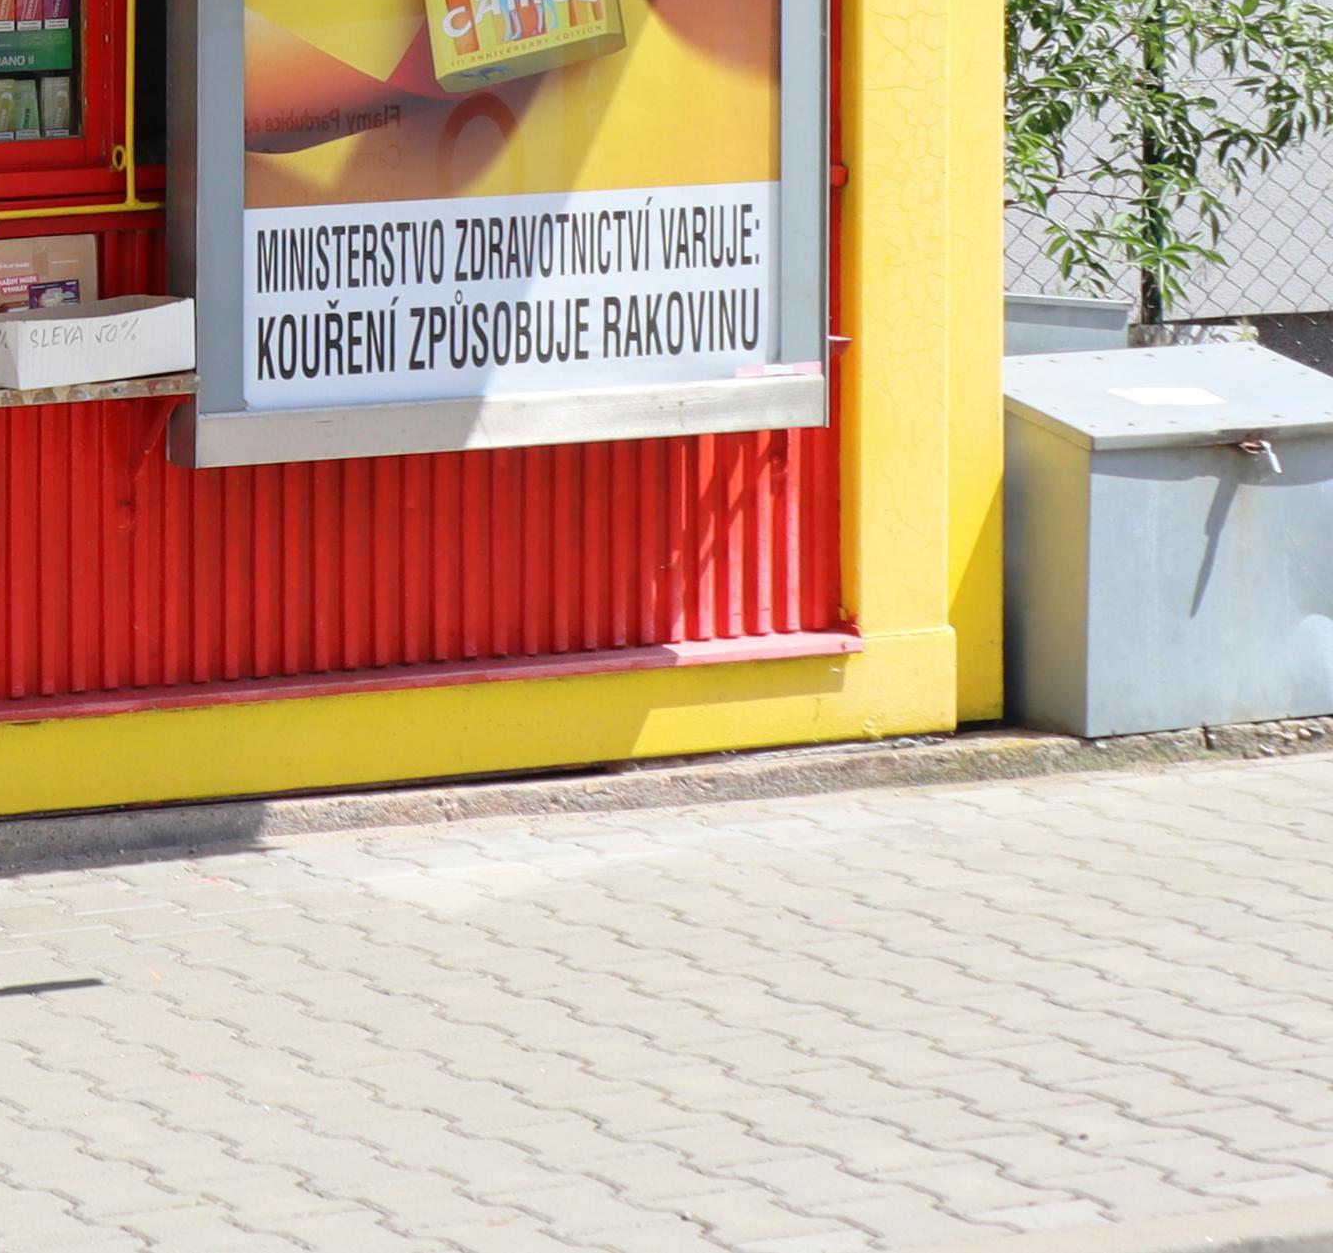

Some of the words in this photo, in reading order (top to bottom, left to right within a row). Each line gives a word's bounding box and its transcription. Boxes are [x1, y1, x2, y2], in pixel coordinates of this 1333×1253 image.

[470, 35, 551, 63] ANNIVERSARY
[554, 23, 604, 44] EDITION
[255, 218, 445, 295] MINISTERSTVO
[453, 196, 654, 284] ZDRAVOTNICTVÍ
[658, 203, 761, 270] VARUJE:
[29, 325, 85, 350] SLEVA
[94, 317, 139, 343] 50%
[256, 296, 400, 382] KOUŘENÍ
[408, 288, 591, 371] ZPŮSOBUJE
[602, 286, 761, 359] RAKOVINU
